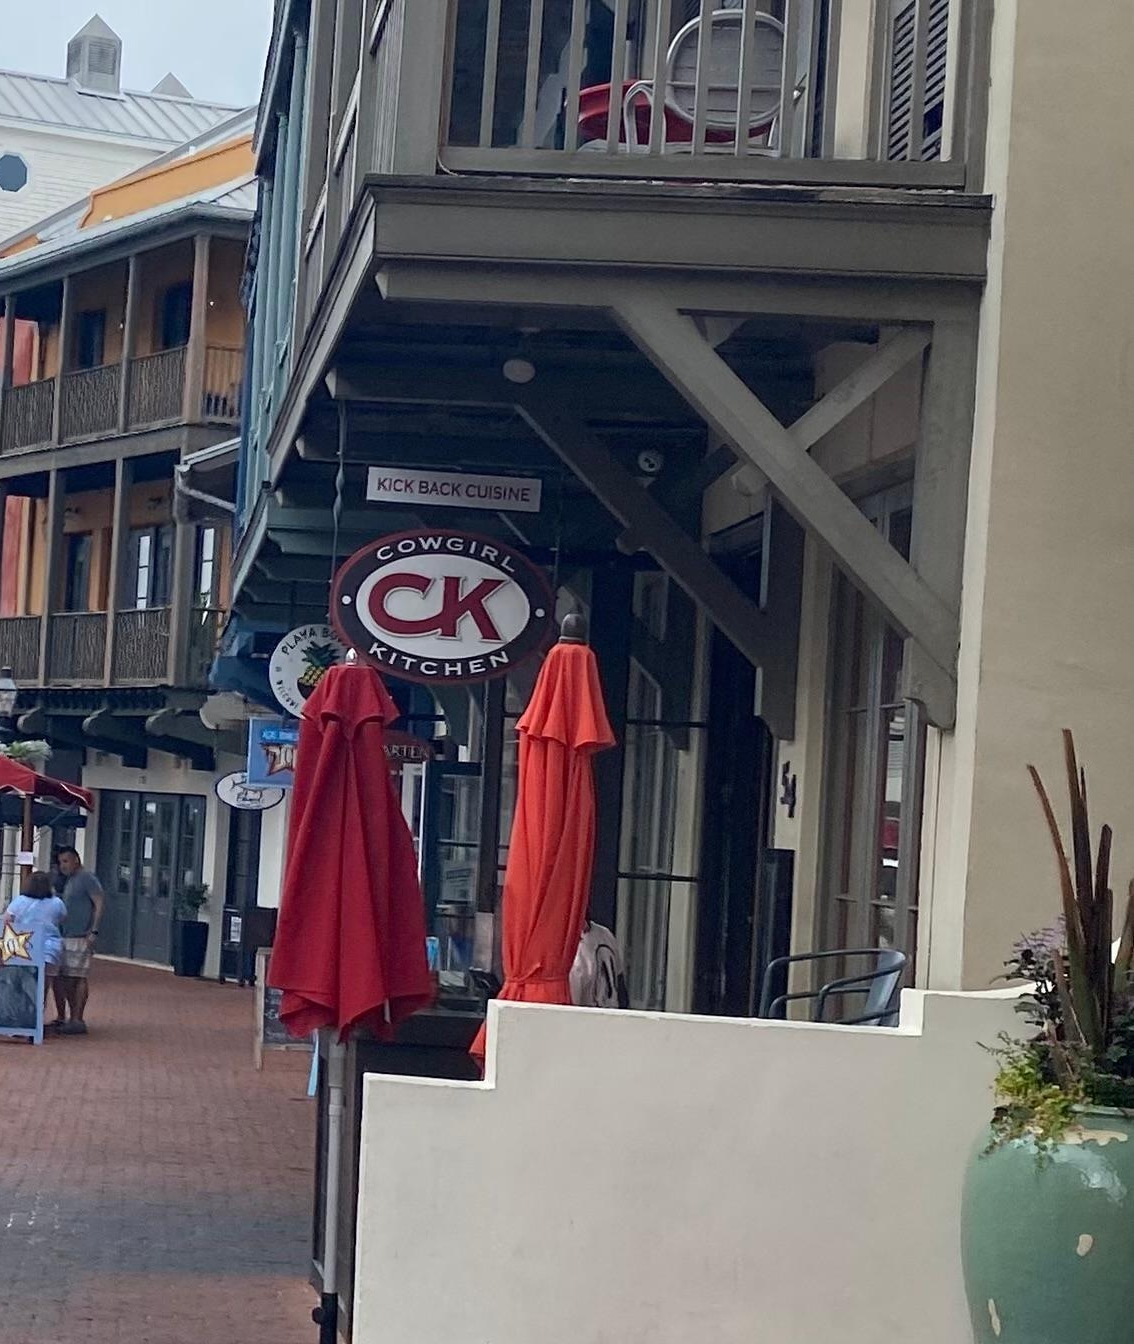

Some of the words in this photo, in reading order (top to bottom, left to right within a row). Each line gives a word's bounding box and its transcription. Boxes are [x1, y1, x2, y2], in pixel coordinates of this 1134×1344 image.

[377, 477, 415, 494] KICK
[418, 480, 462, 497] BACK
[466, 484, 531, 502] CUISINE
[376, 536, 515, 573] COWGIRL
[368, 572, 508, 643] CK
[281, 627, 317, 656] PLAYA
[369, 641, 510, 676] KITCHEN
